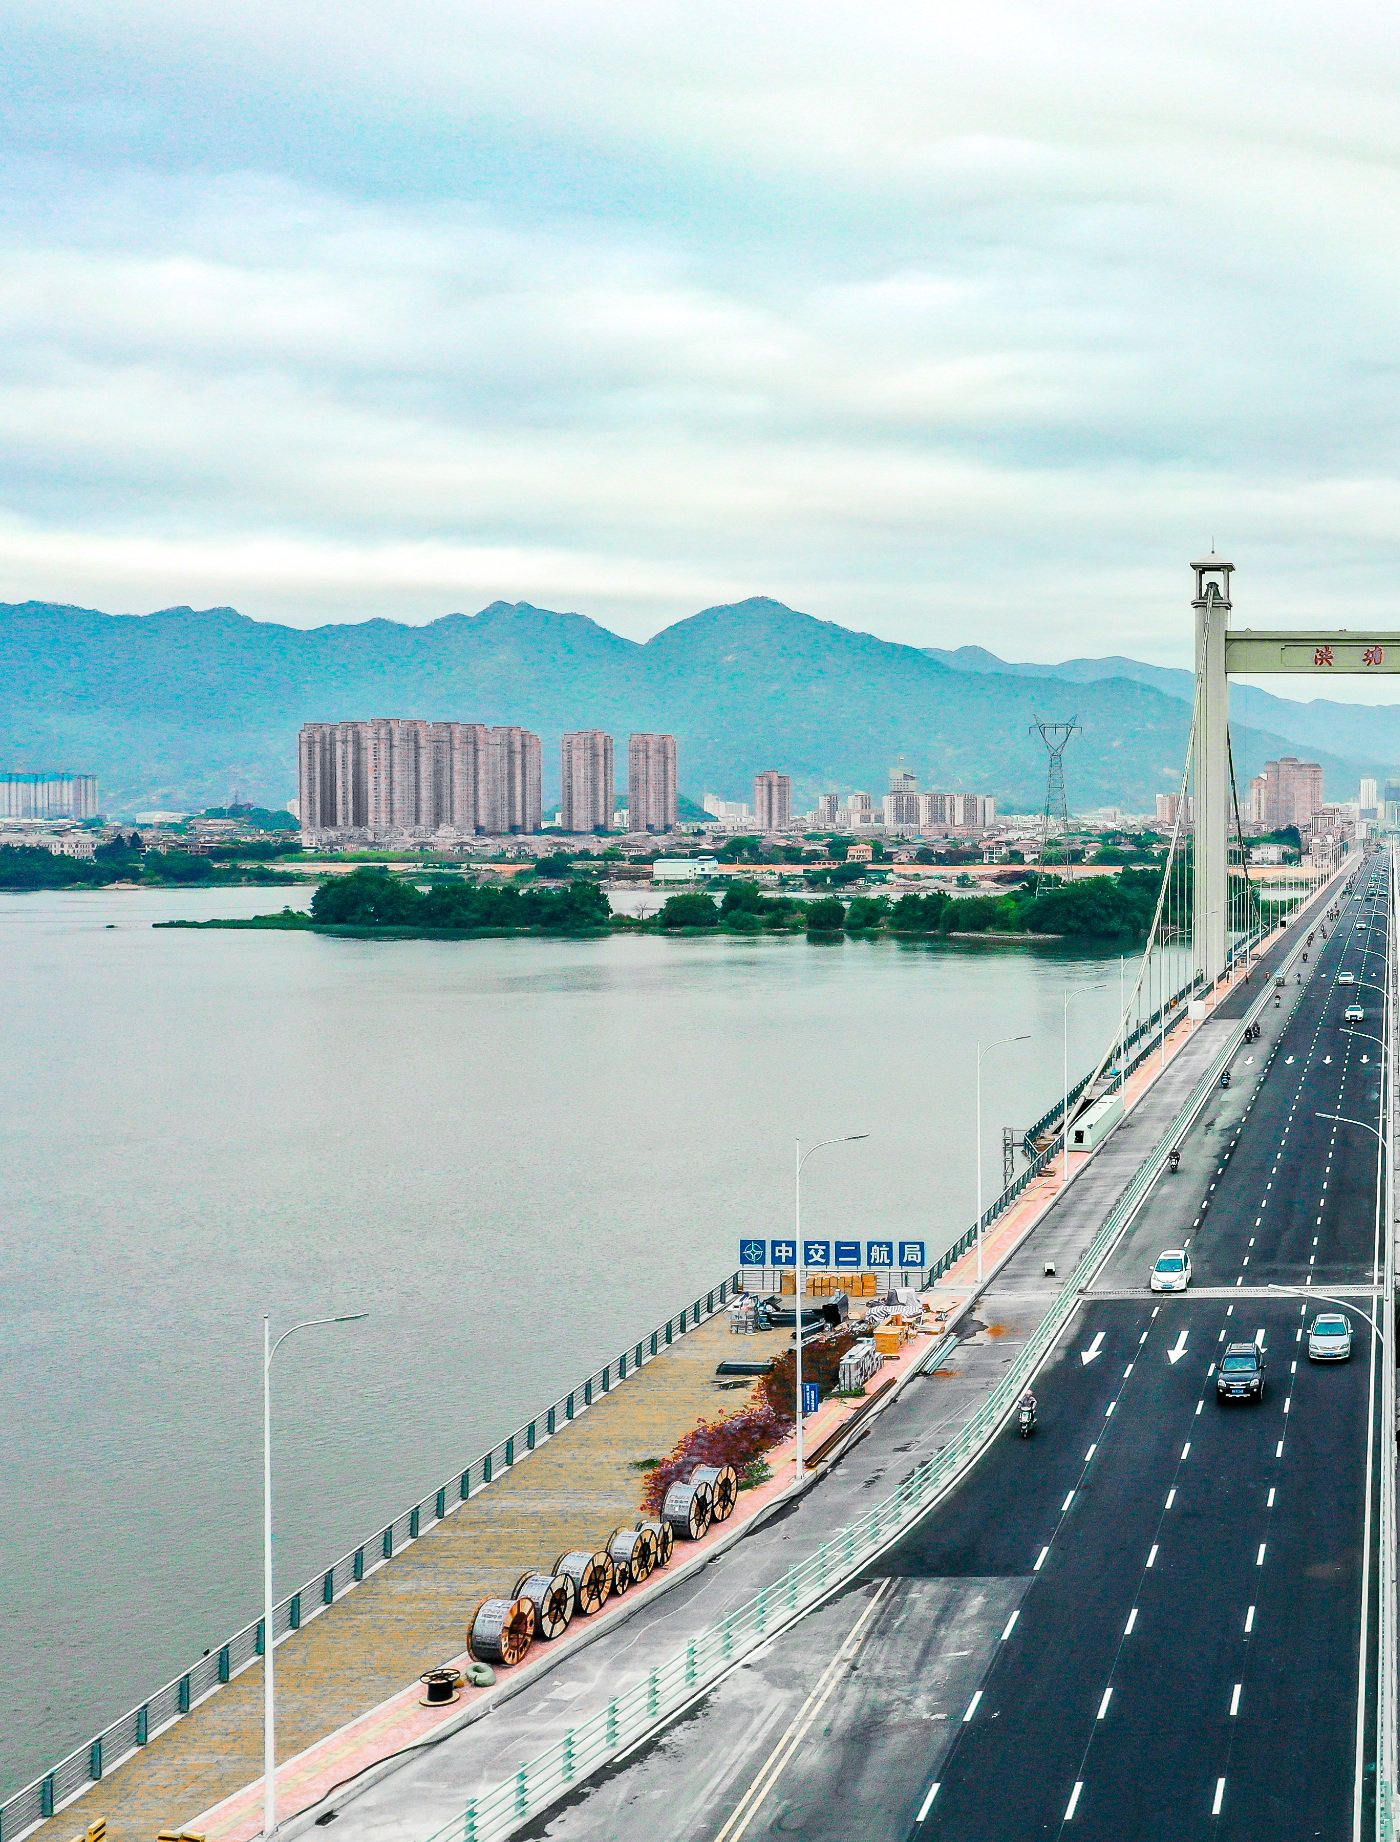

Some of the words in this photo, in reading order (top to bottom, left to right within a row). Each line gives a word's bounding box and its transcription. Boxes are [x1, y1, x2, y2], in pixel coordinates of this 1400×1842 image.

[775, 1243, 922, 1263] 中交二航局
